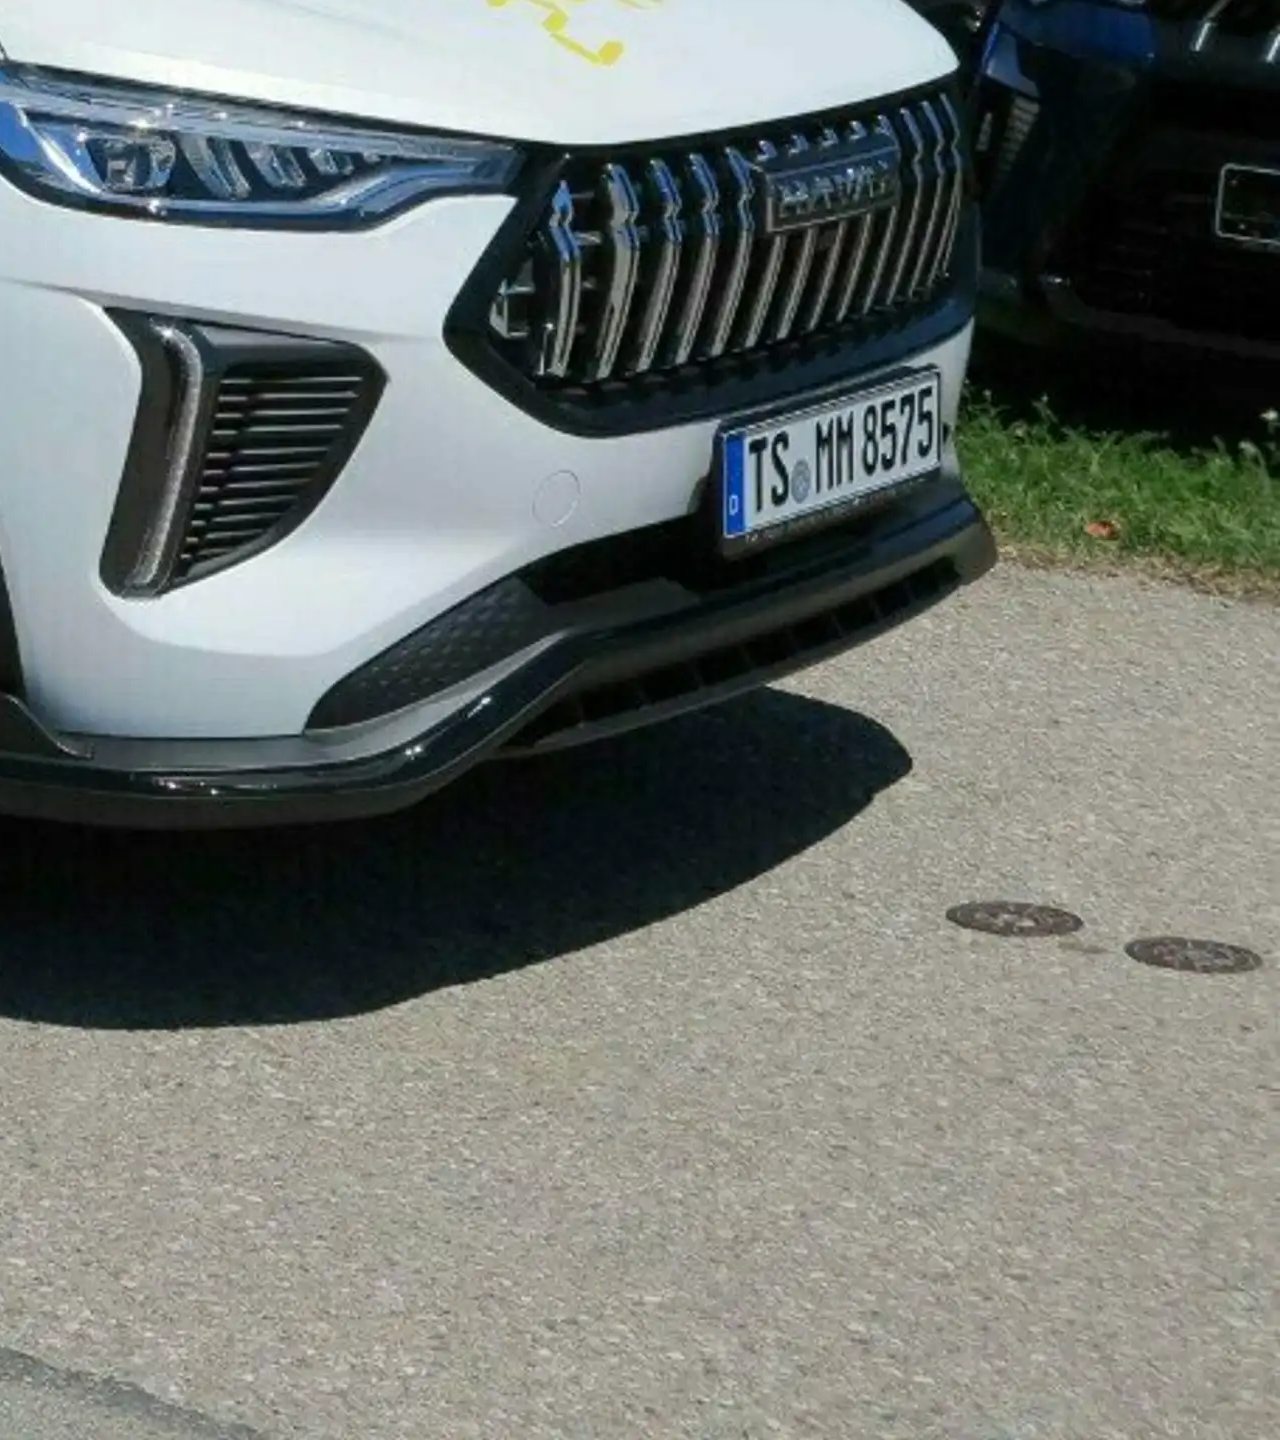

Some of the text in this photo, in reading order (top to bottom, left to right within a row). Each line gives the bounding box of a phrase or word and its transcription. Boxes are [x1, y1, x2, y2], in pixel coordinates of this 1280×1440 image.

[748, 430, 790, 513] TS
[815, 410, 854, 494] MM
[862, 385, 934, 477] 8575
[728, 493, 739, 517] D
